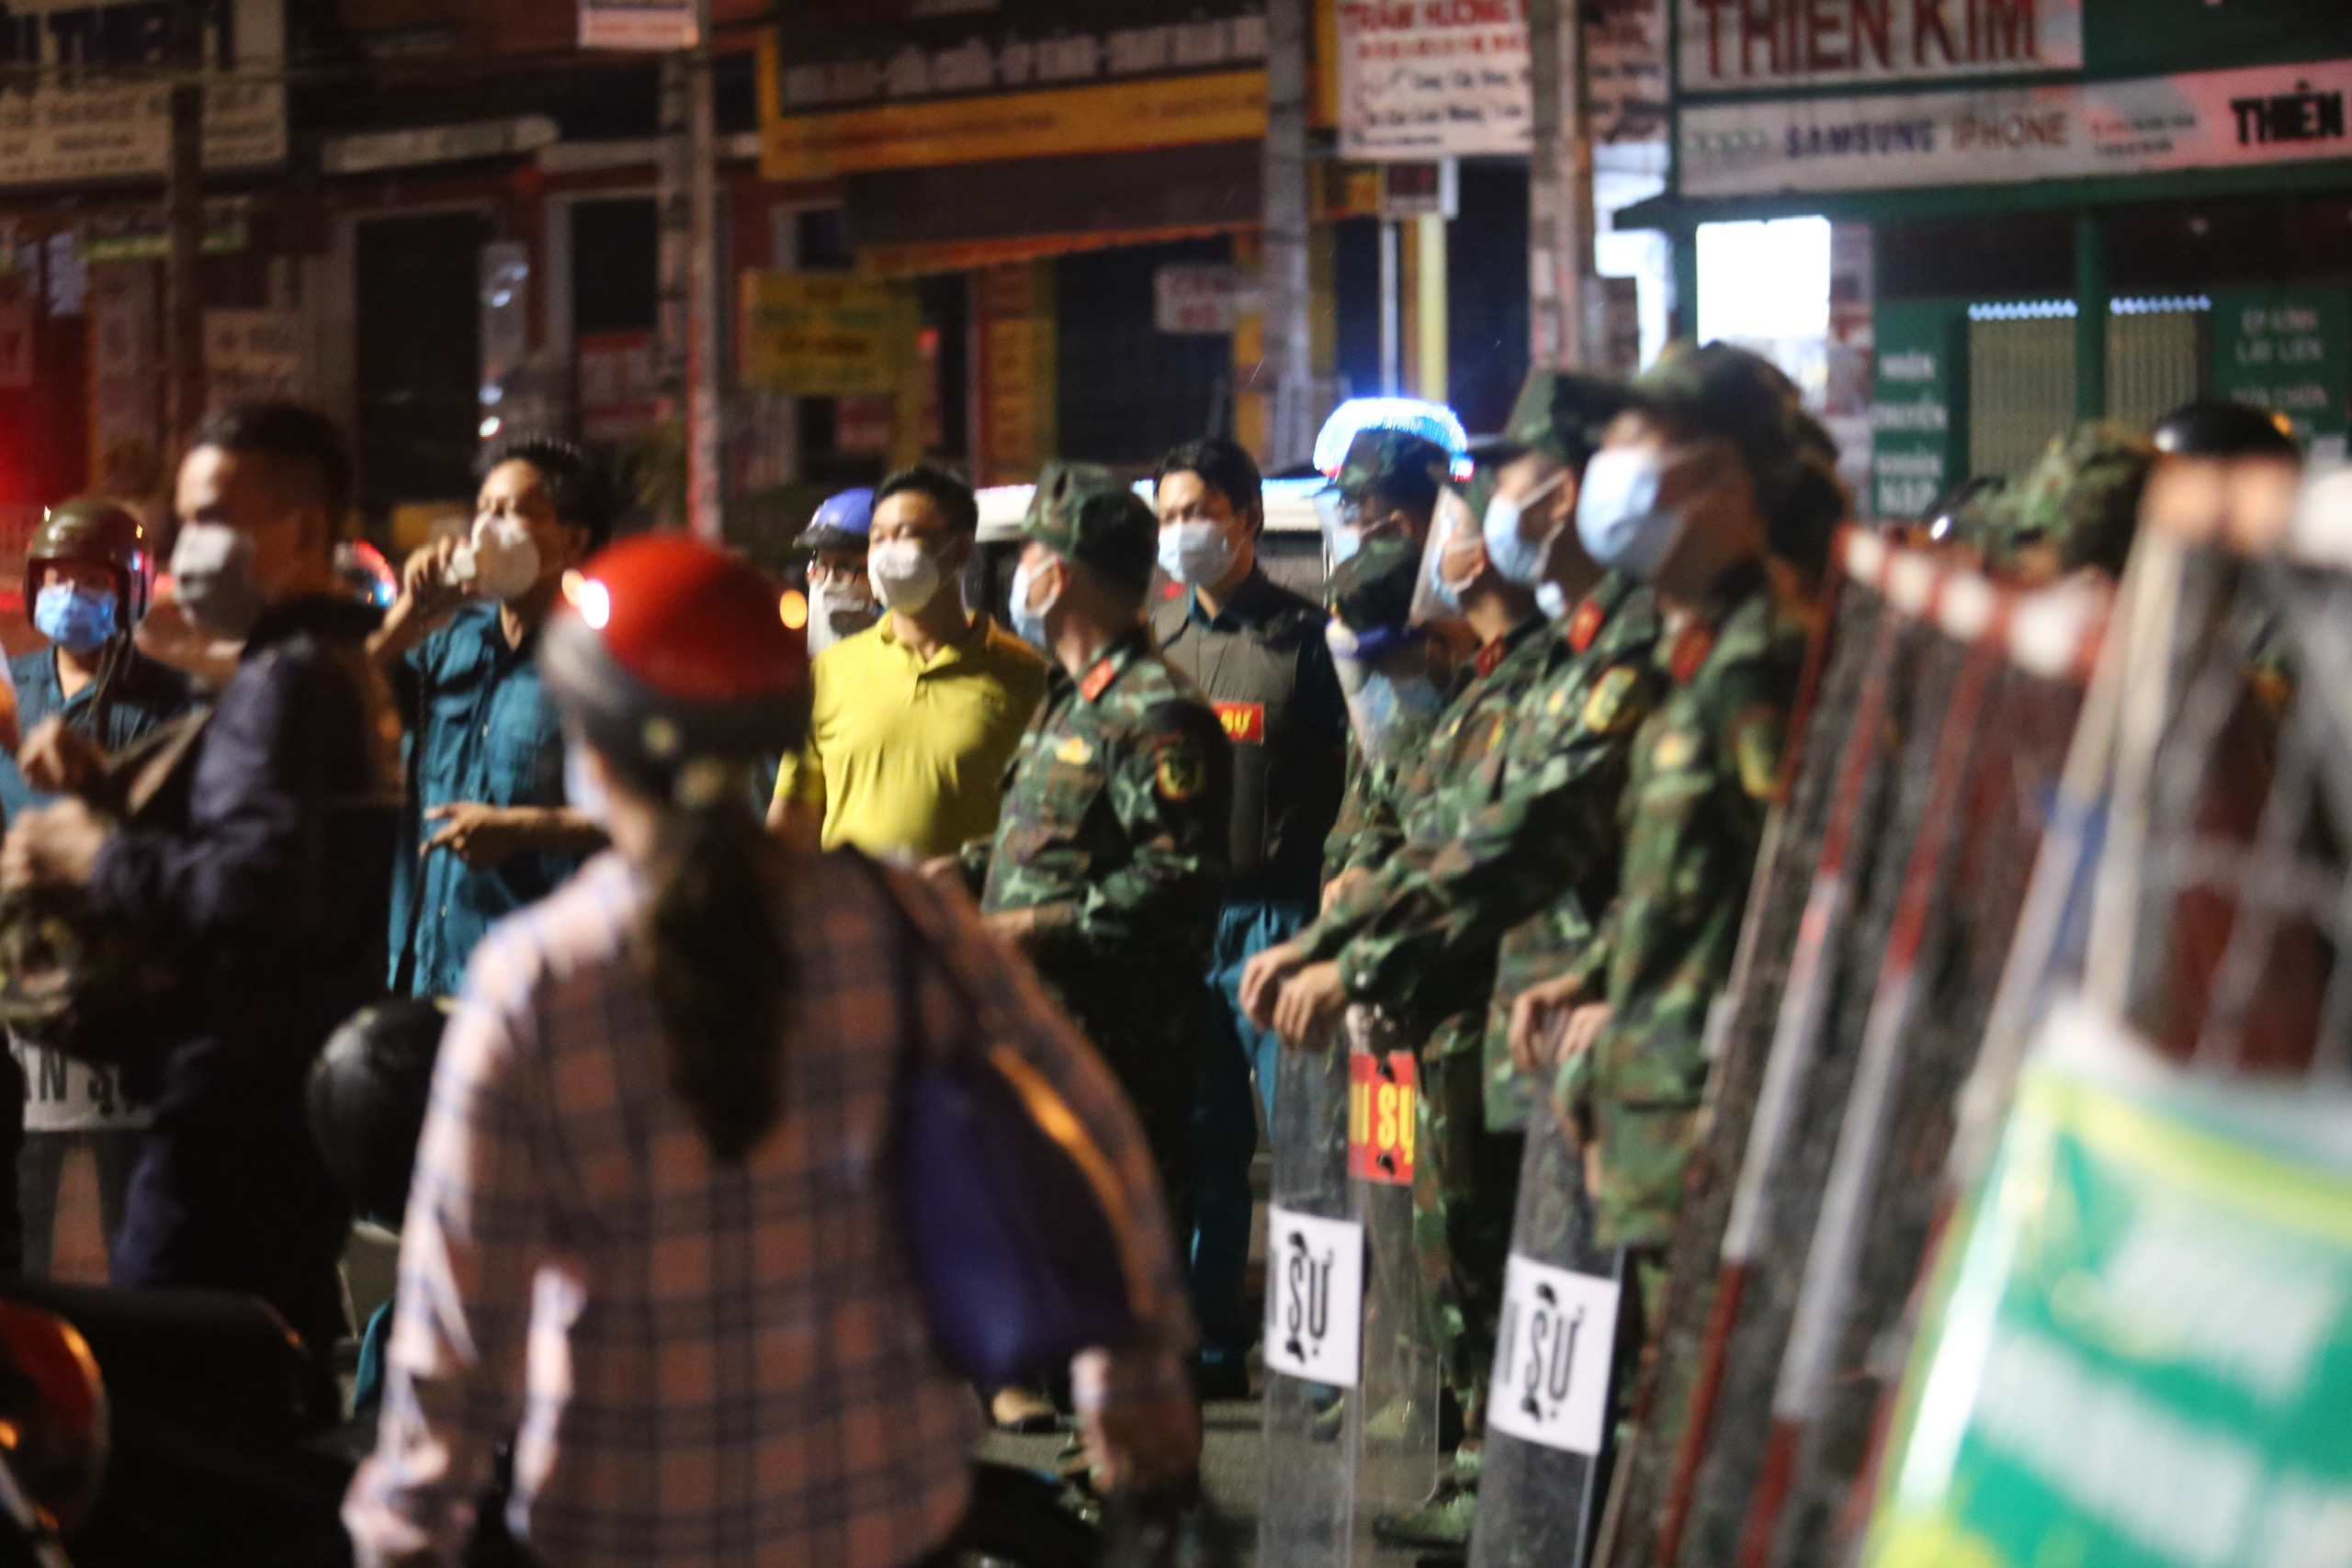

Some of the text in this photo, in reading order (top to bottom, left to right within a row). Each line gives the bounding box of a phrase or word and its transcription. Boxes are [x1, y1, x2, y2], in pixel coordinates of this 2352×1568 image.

[1915, 0, 2037, 68] KIM
[1785, 119, 1934, 158] SAMSUNG
[1950, 110, 2069, 152] IPHONE
